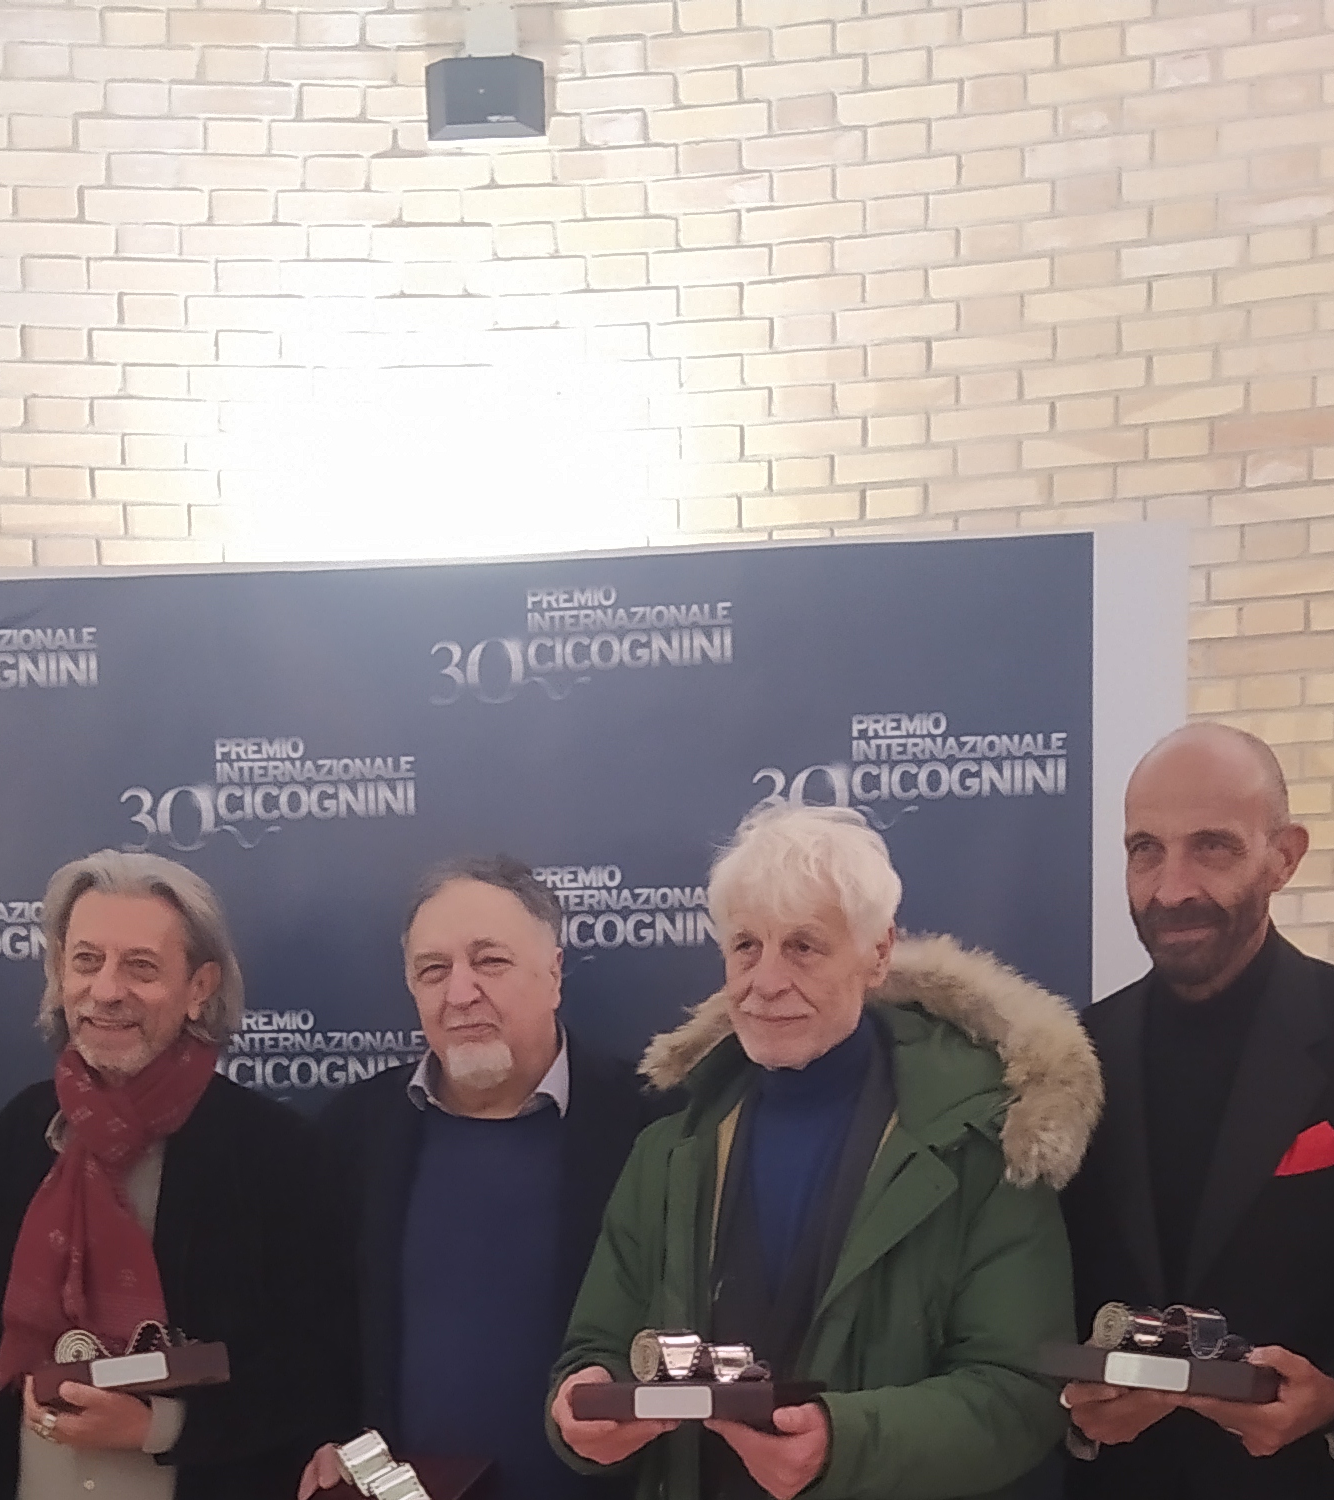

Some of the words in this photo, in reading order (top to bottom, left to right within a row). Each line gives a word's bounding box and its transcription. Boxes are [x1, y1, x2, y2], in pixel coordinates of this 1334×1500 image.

[526, 587, 616, 609] PREMIO
[527, 602, 732, 633] INTERNAZIONALE
[527, 628, 734, 673] CICOGNINI
[852, 712, 948, 738] PREMIO
[215, 736, 305, 760] PREMIO
[852, 732, 1068, 762] INTERNAZIONALE
[217, 755, 416, 783] INTERNAZIONALE
[852, 758, 1067, 801] CICOGNINI
[217, 781, 416, 821] CICOGNINI
[554, 886, 709, 912] TERNAZIONA
[560, 910, 718, 949] ICOGNIN
[241, 1009, 315, 1031] REMIO
